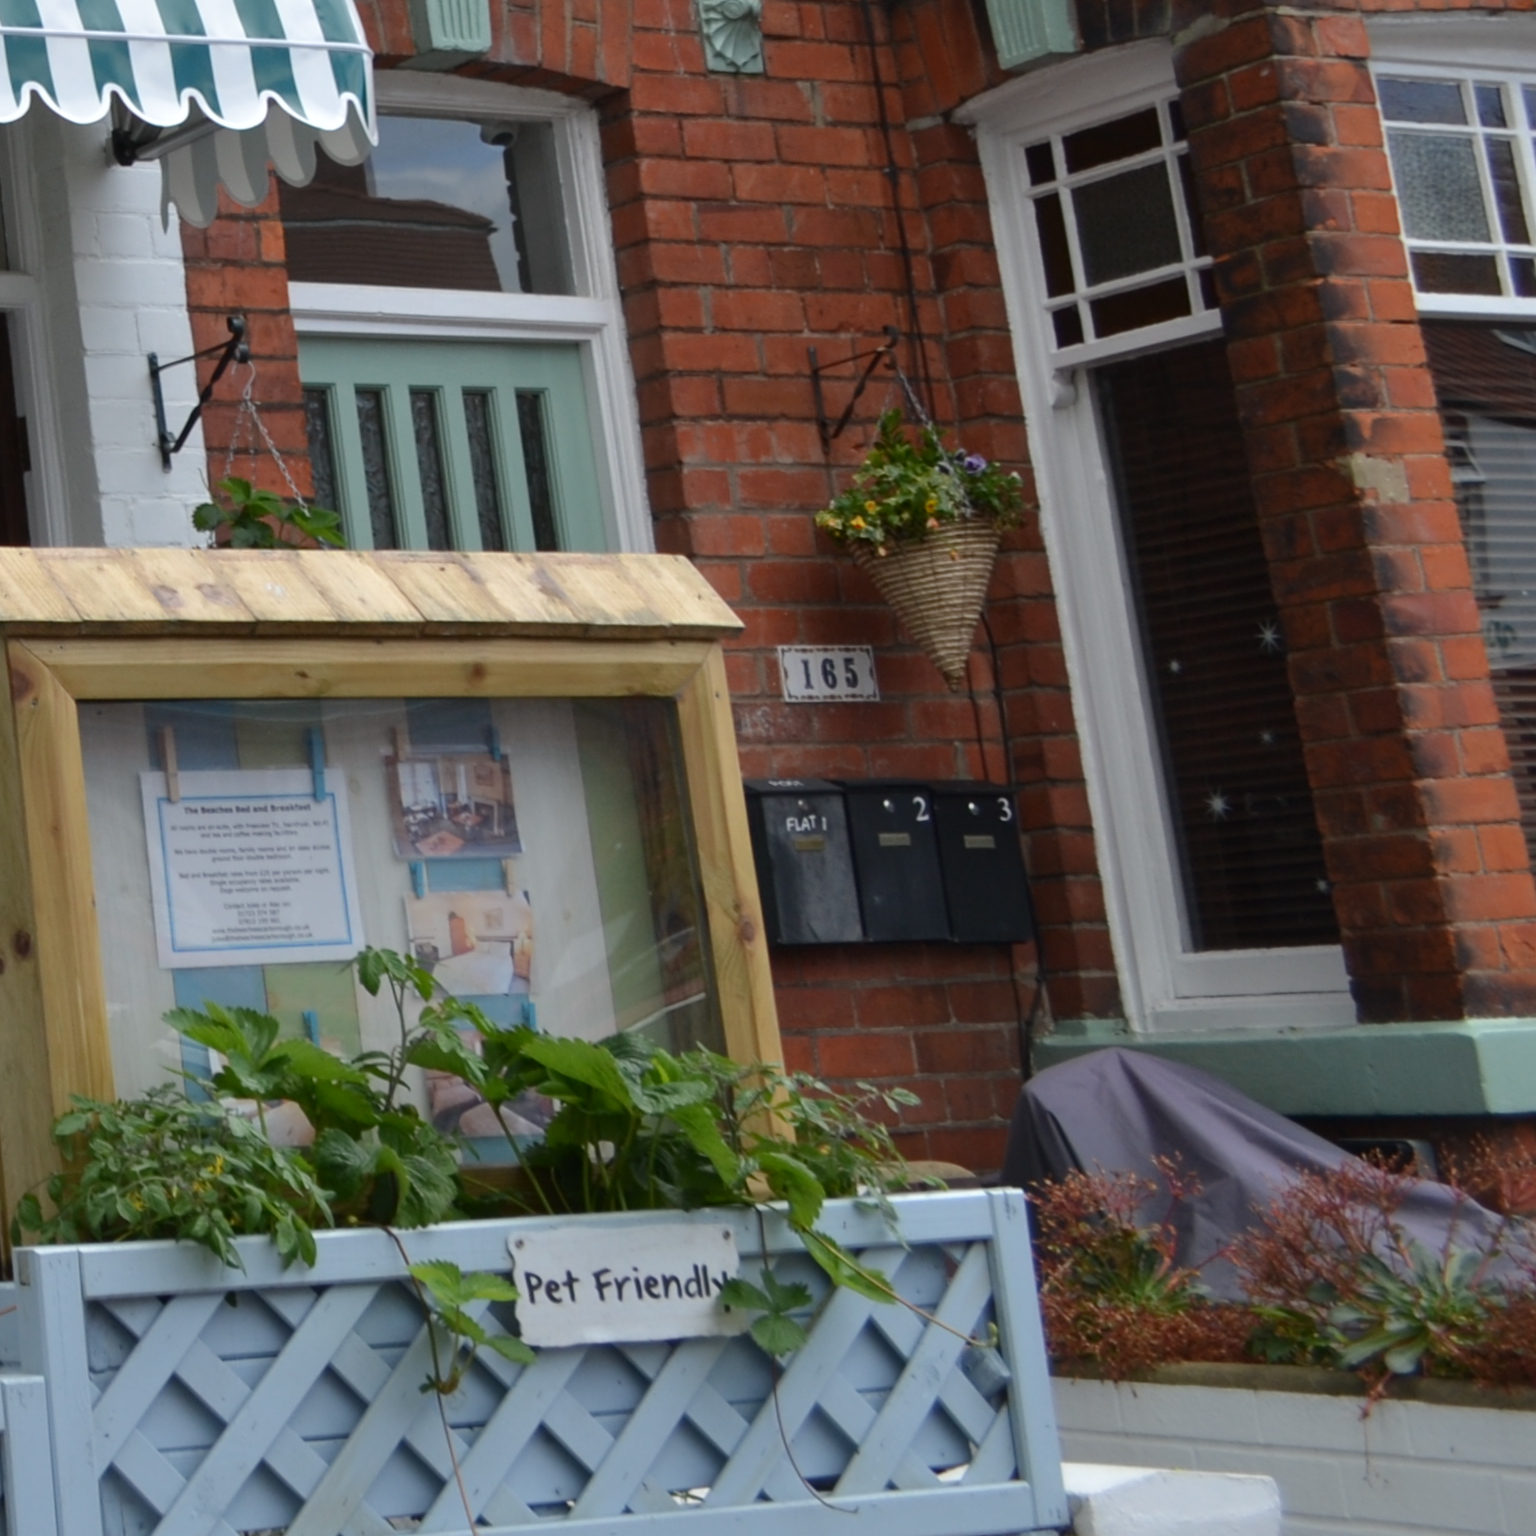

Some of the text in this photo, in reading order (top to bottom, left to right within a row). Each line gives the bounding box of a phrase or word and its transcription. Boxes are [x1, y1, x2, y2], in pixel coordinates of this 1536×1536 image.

[800, 657, 860, 691] 165
[912, 796, 930, 822] 2
[997, 797, 1013, 822] 3
[785, 813, 817, 833] FLAT
[524, 1269, 581, 1305] Pet
